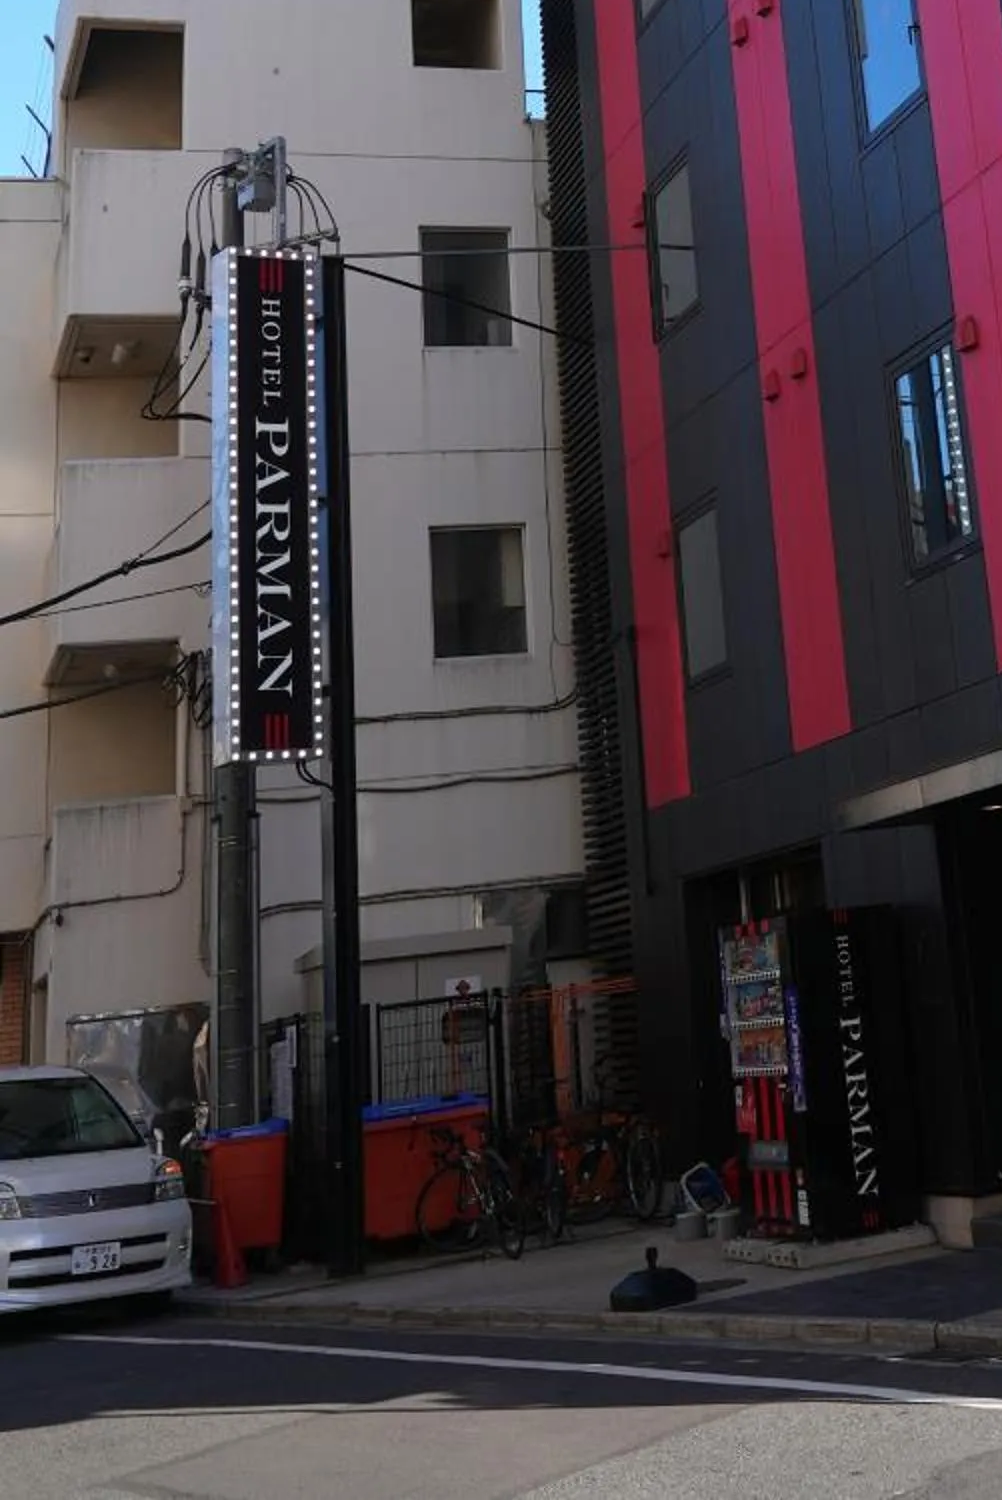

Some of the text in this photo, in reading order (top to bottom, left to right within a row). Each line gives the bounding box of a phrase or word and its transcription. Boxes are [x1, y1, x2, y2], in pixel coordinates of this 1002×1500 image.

[255, 297, 293, 697] HOTEL PARMAN
[836, 935, 879, 1197] HOTEL PARMAN
